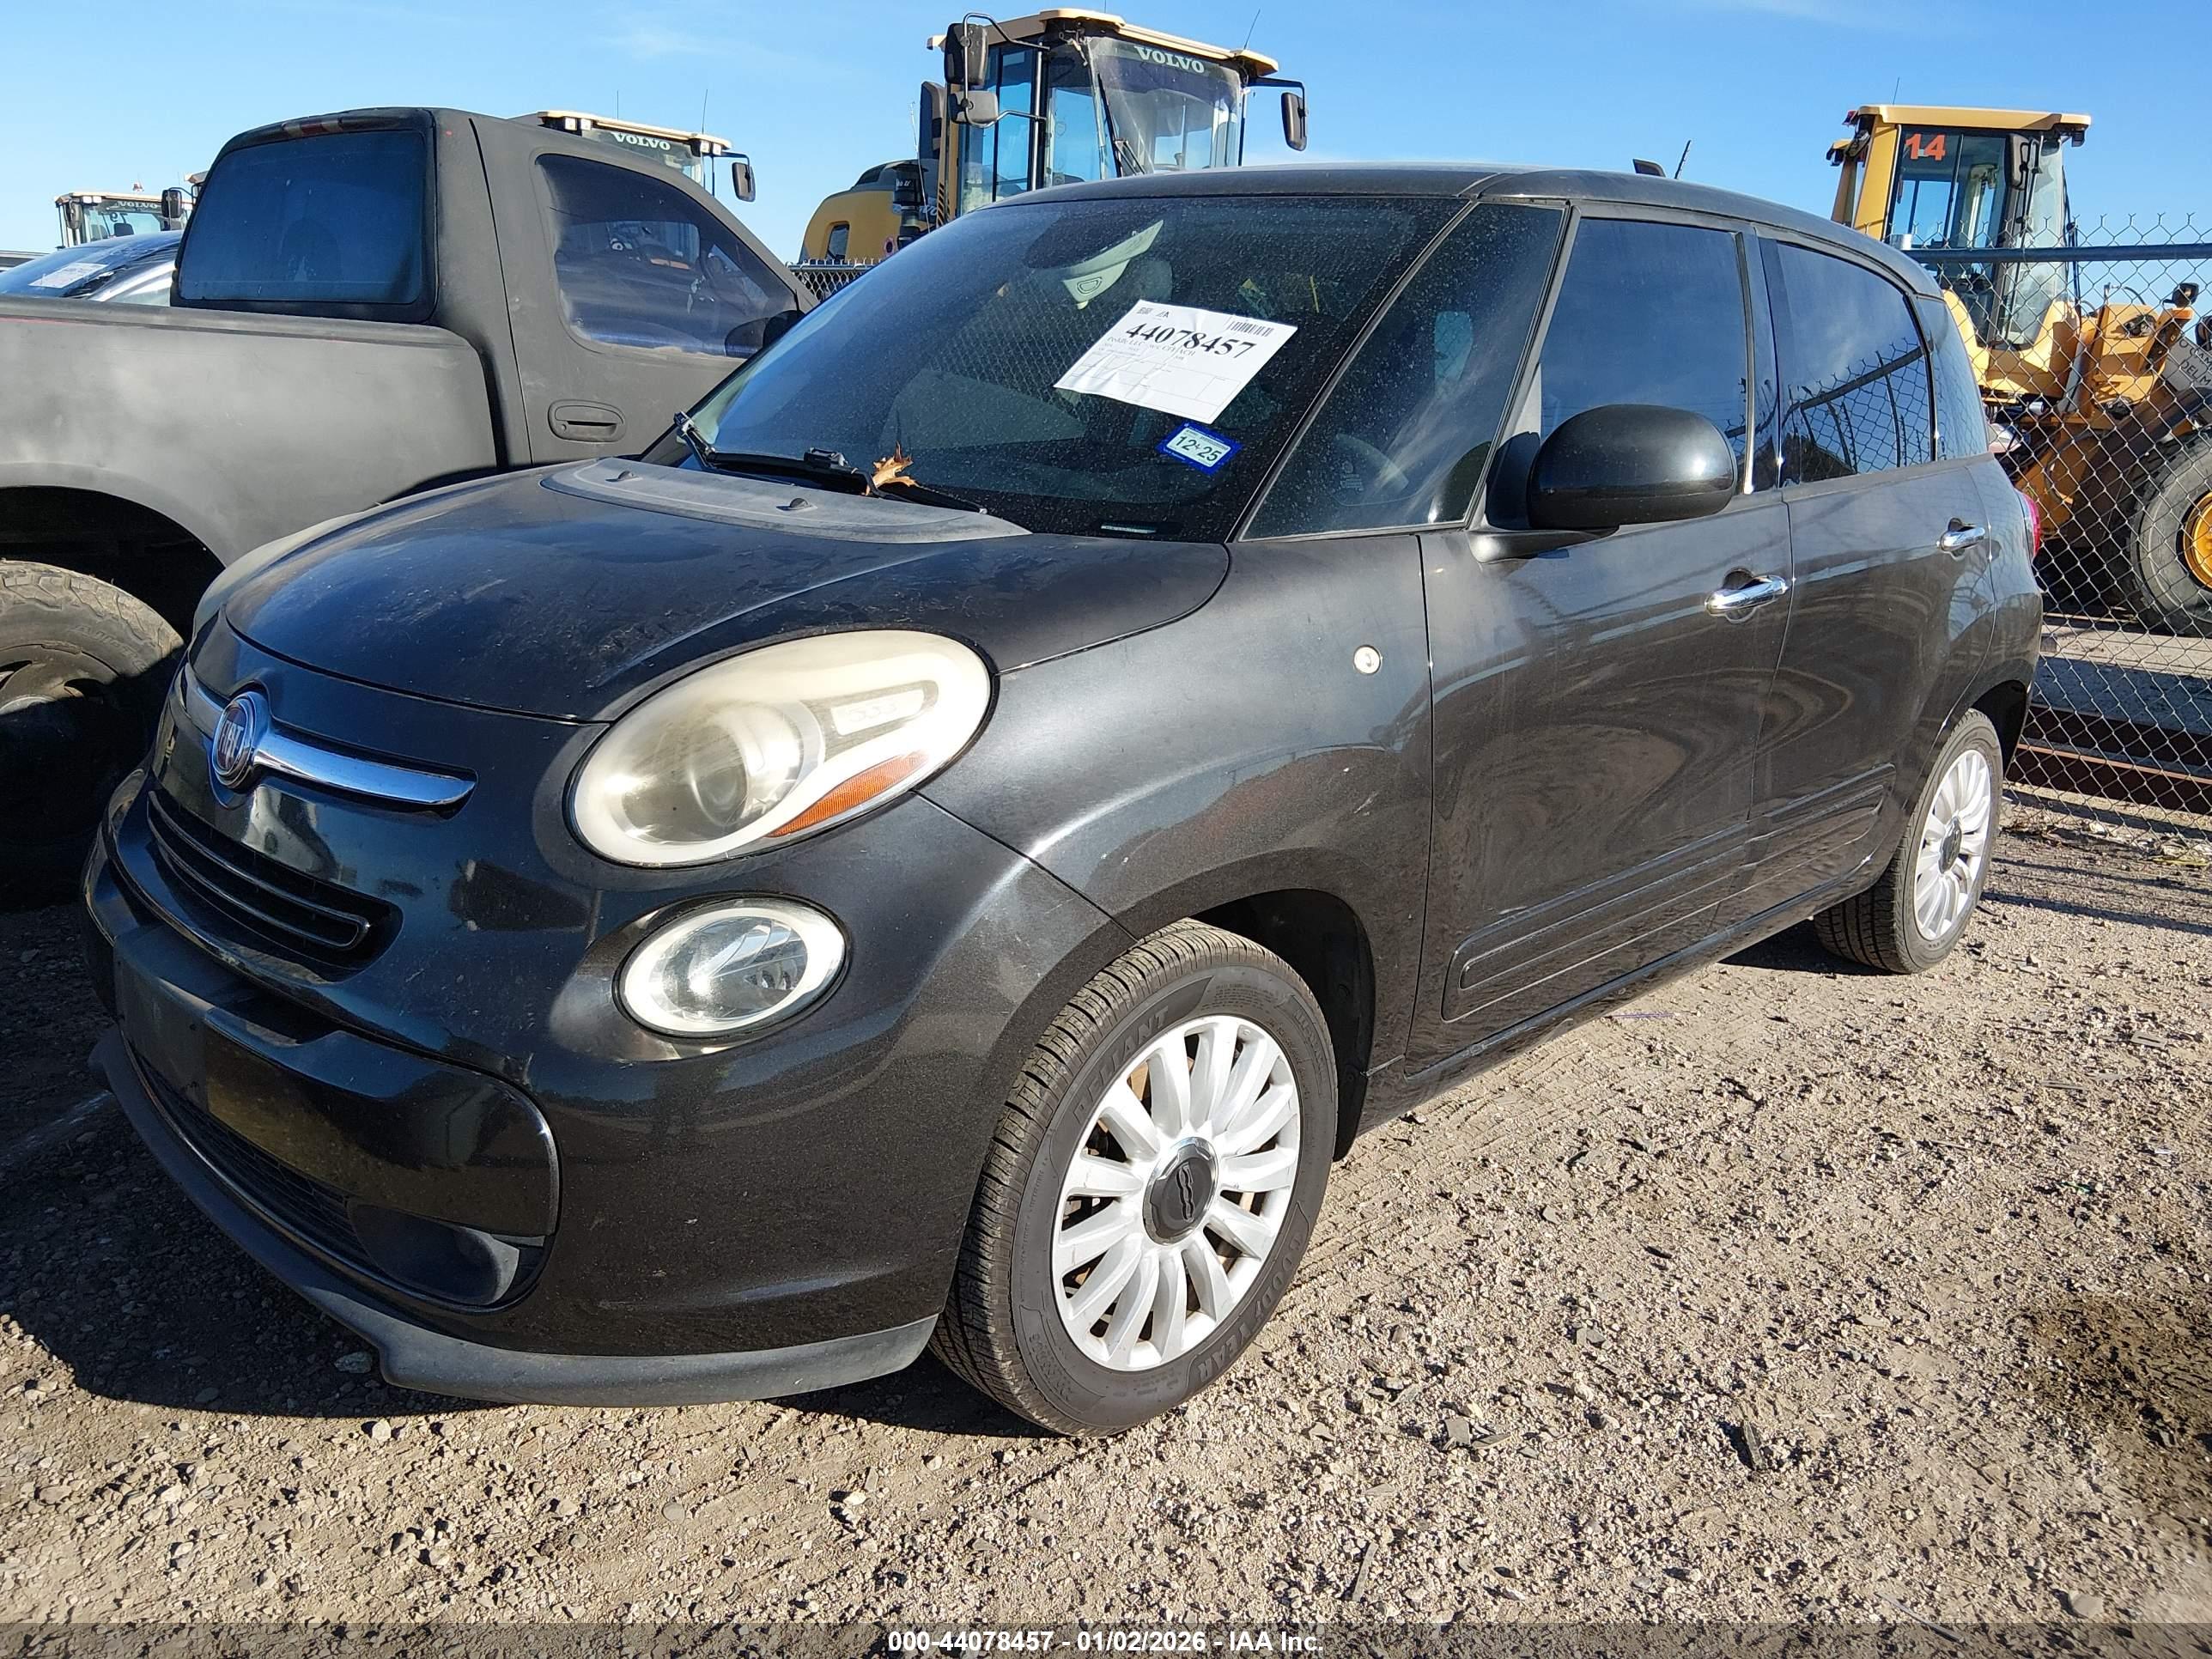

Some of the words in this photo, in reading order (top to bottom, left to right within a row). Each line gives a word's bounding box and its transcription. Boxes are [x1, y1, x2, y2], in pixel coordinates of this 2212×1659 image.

[1133, 46, 1205, 74] VOLVO
[611, 131, 671, 151] VOLVO
[1905, 133, 1946, 161] 14
[116, 200, 158, 209] VOLVO
[1126, 323, 1259, 359] 44078457
[218, 720, 246, 763] FIAT
[1073, 1005, 1169, 1126] RELIANT
